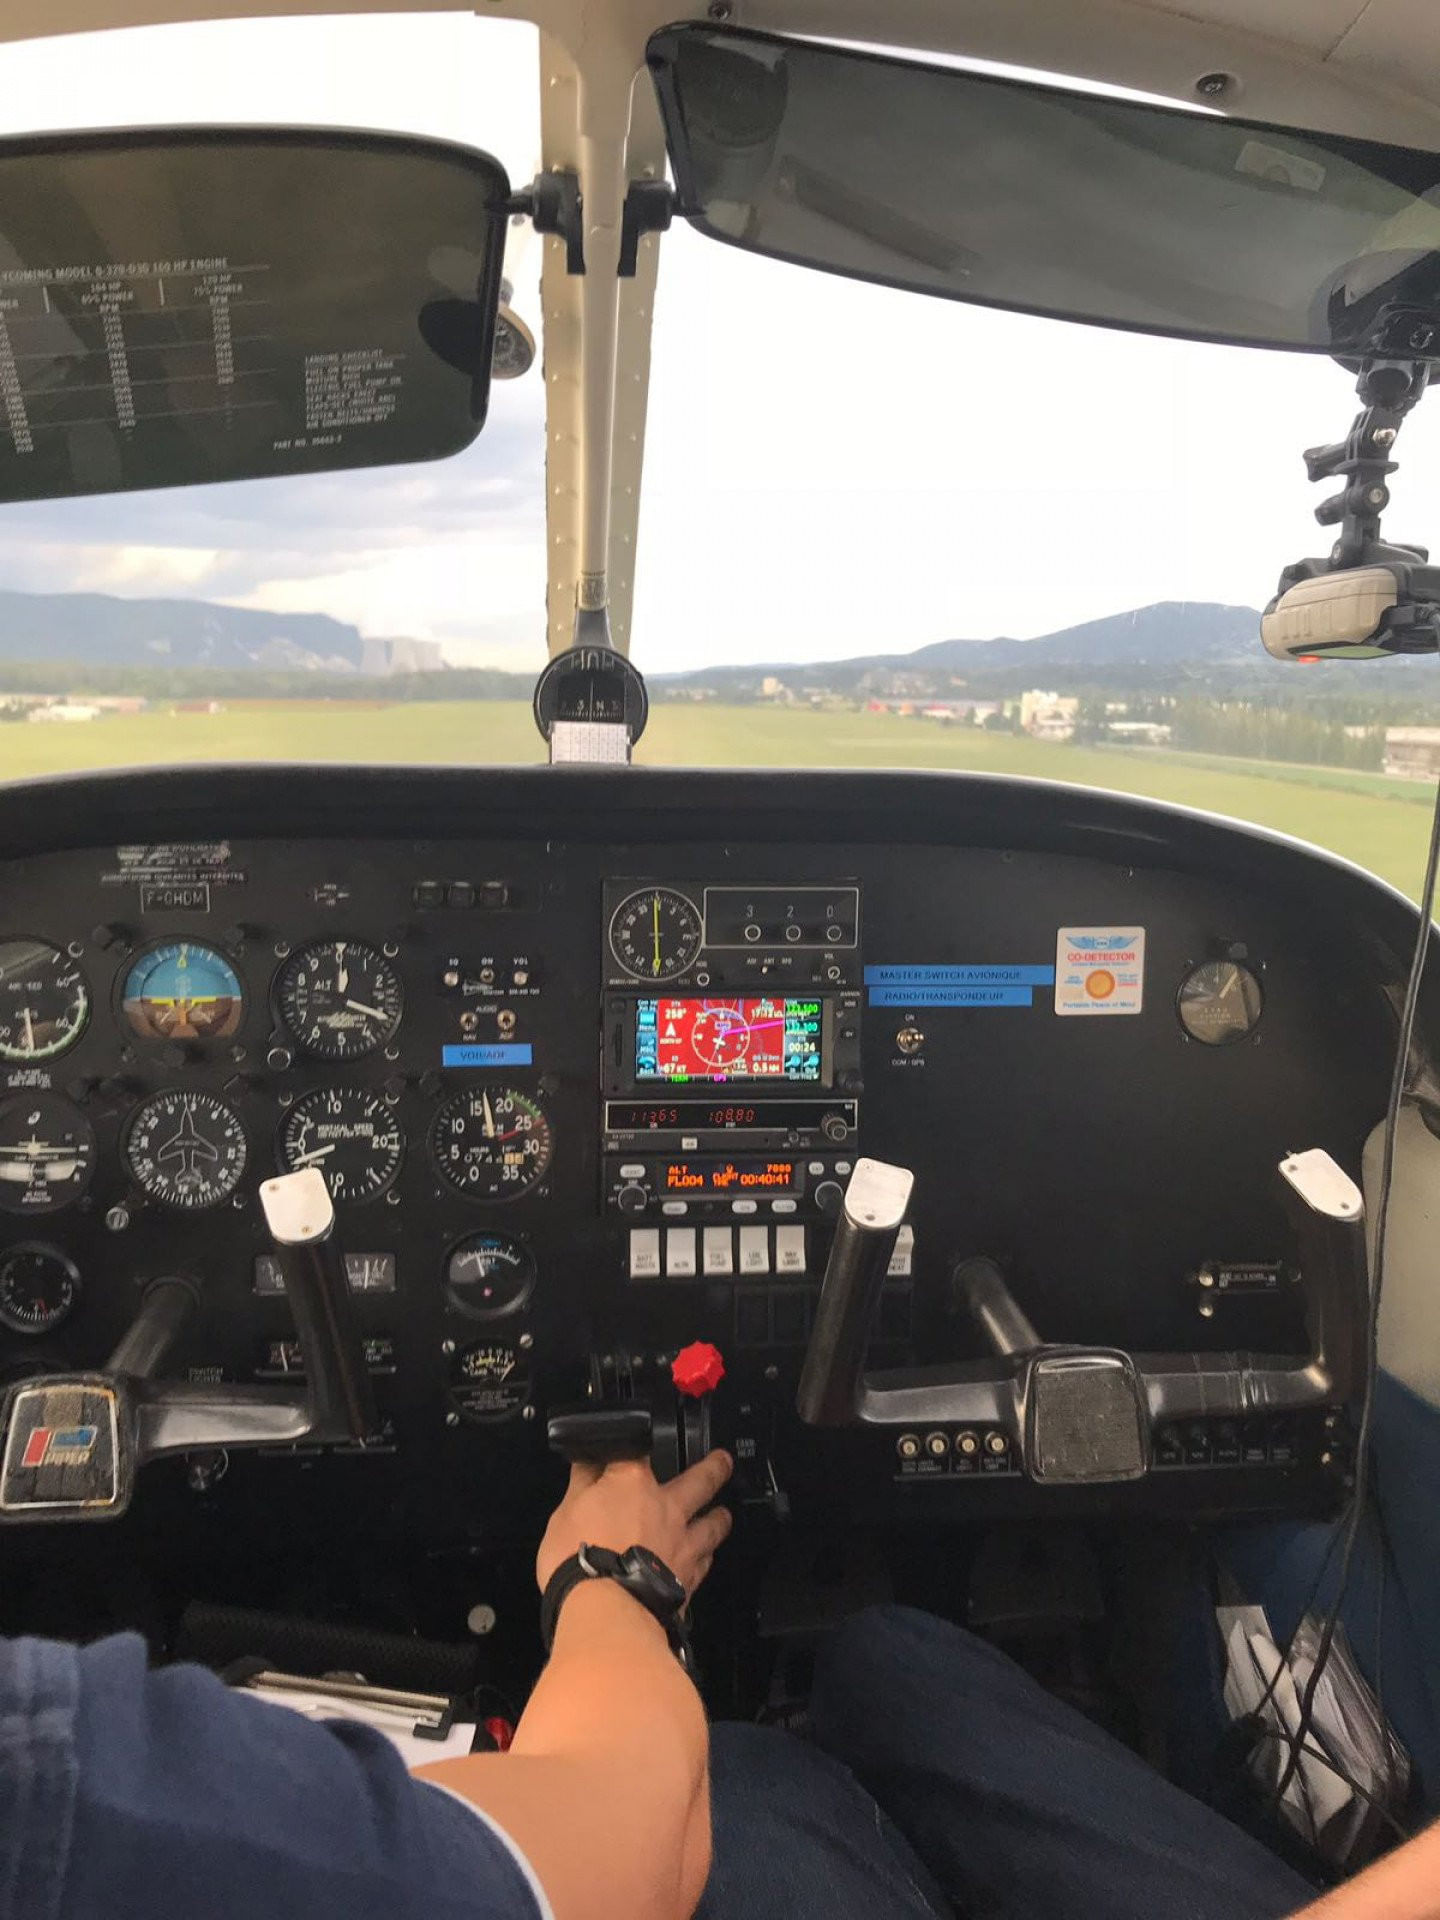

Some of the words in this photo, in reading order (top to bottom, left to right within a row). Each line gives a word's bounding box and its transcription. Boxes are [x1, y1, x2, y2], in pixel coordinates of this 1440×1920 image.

[786, 905, 794, 918] 2
[826, 904, 834, 918] 0
[481, 957, 494, 966] ON
[1067, 951, 1136, 961] CO-DETECTOR
[310, 958, 318, 972] 9
[298, 972, 305, 986] 8
[376, 974, 383, 988] 2
[879, 970, 924, 981] MASTER
[925, 970, 965, 980] SWITCH
[967, 970, 1021, 981] AVIONIQUE
[314, 979, 332, 991] ALT
[884, 991, 1004, 1001] RADIO/TRANSPONDEUR
[789, 1042, 816, 1053] 00:24
[328, 1099, 342, 1114] 10
[469, 1100, 483, 1117] 15
[495, 1097, 514, 1113] 20
[451, 1117, 465, 1134] 10
[515, 1114, 532, 1131] 25
[372, 1134, 388, 1149] 20
[523, 1139, 540, 1155] 30
[451, 1143, 460, 1160] 5
[469, 1165, 479, 1182] 0
[502, 1164, 520, 1181] 35
[668, 1164, 688, 1175] ALT
[330, 1172, 344, 1187] 10
[667, 1174, 704, 1188] FL004
[739, 1173, 789, 1186] 00:40:41
